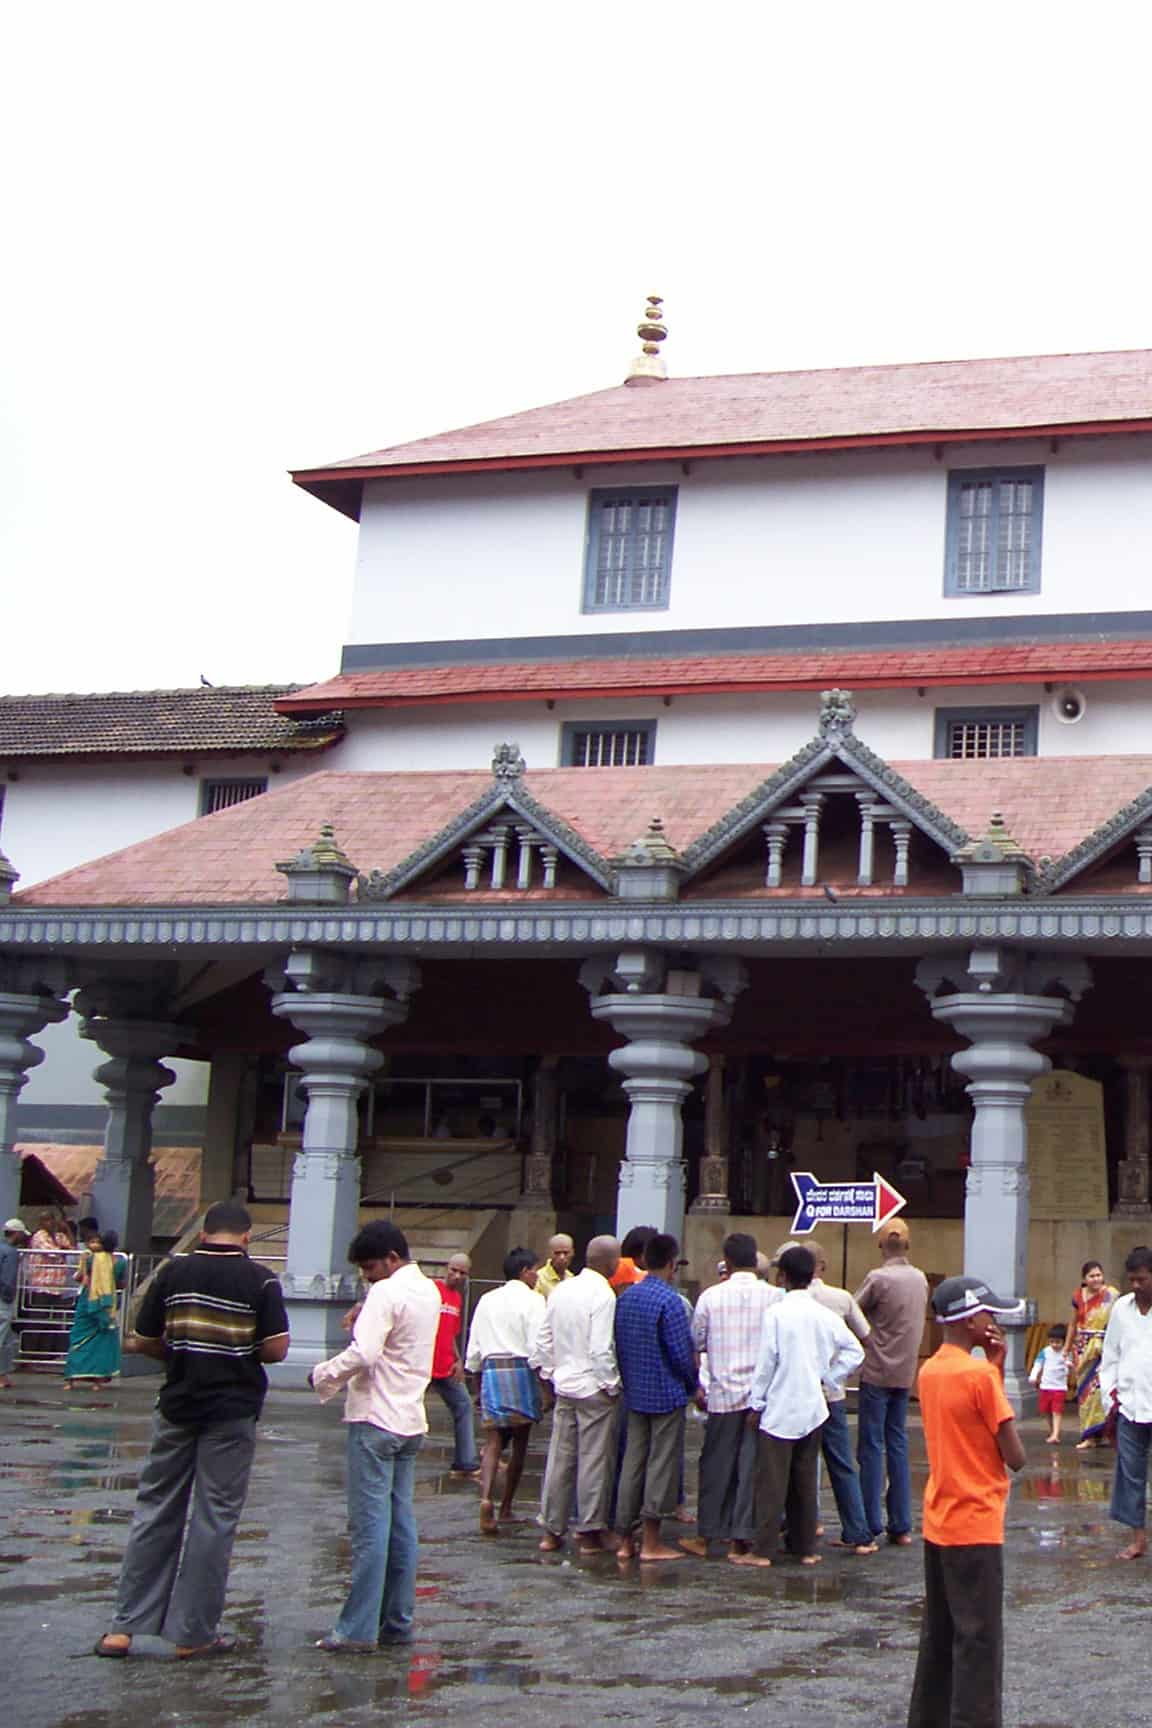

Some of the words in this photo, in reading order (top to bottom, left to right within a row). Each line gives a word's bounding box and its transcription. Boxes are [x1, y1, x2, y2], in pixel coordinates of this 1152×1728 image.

[806, 1205, 815, 1217] Q
[815, 1206, 832, 1217] FOR
[833, 1206, 874, 1217] DARSHAN
